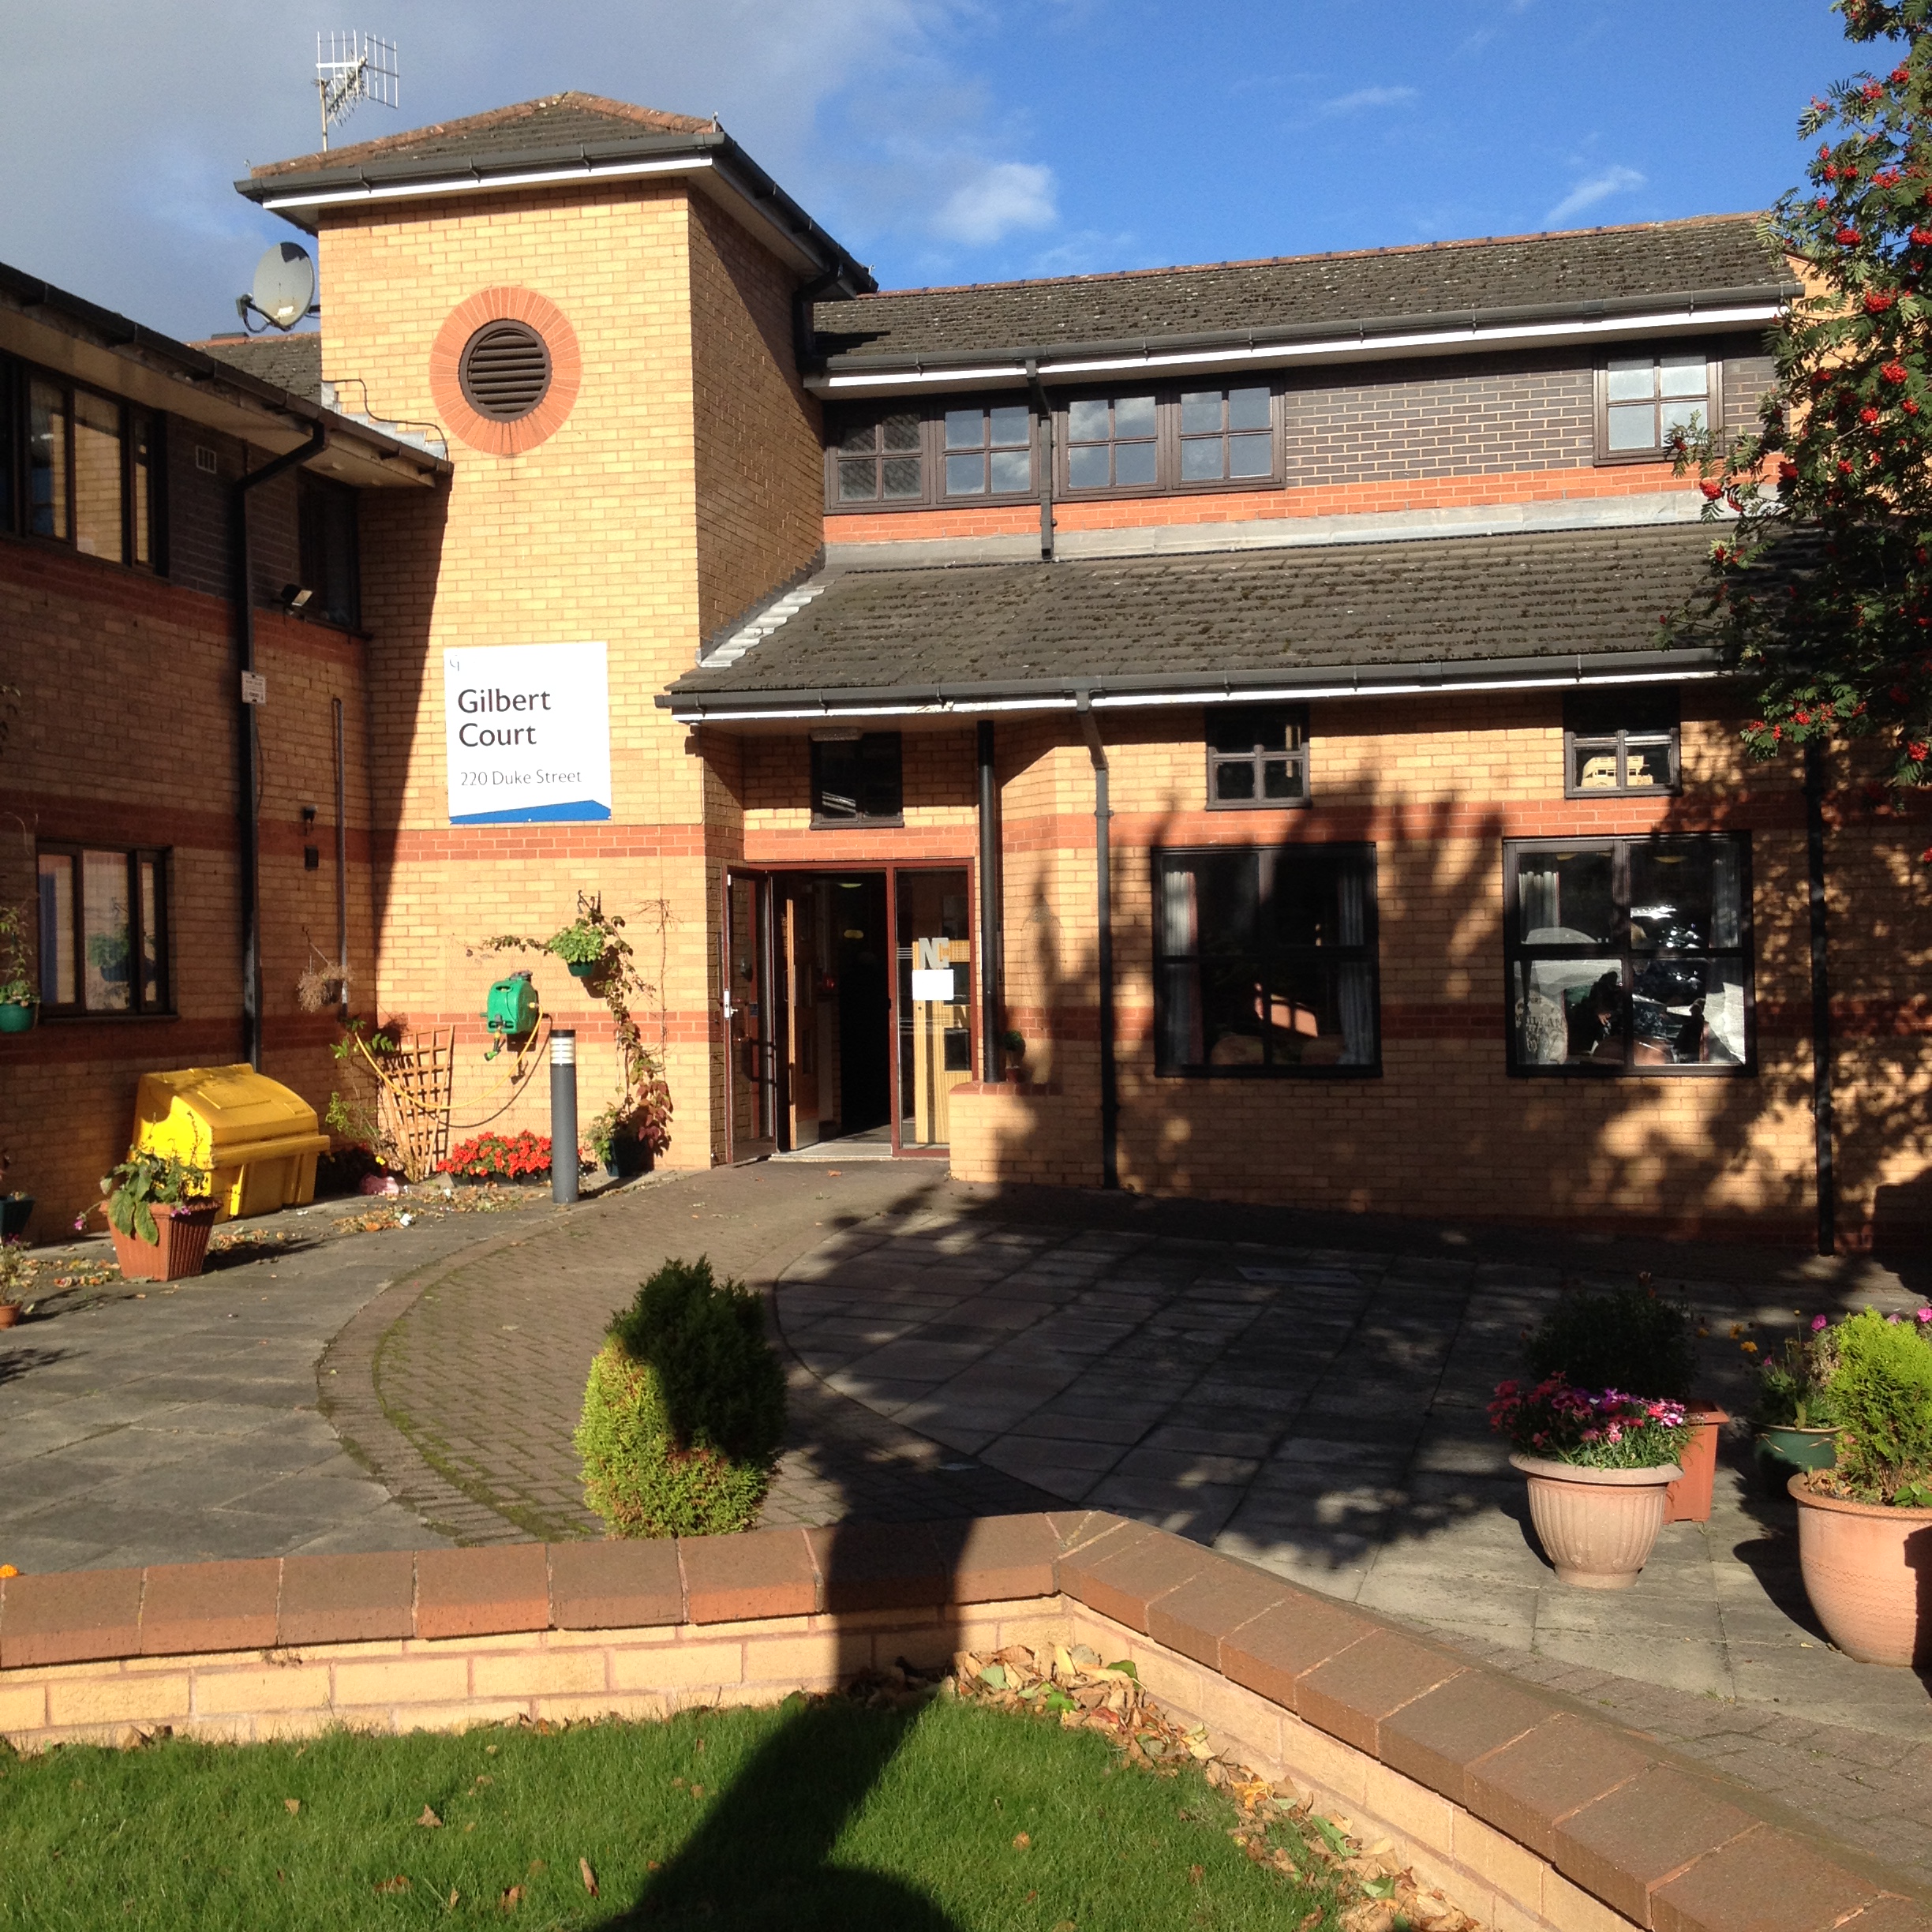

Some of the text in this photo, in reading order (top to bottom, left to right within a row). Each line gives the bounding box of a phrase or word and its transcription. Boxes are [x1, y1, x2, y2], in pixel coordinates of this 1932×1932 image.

[458, 688, 551, 713] Gilbert
[459, 722, 537, 747] Court
[460, 769, 582, 786] 220 Duke Street
